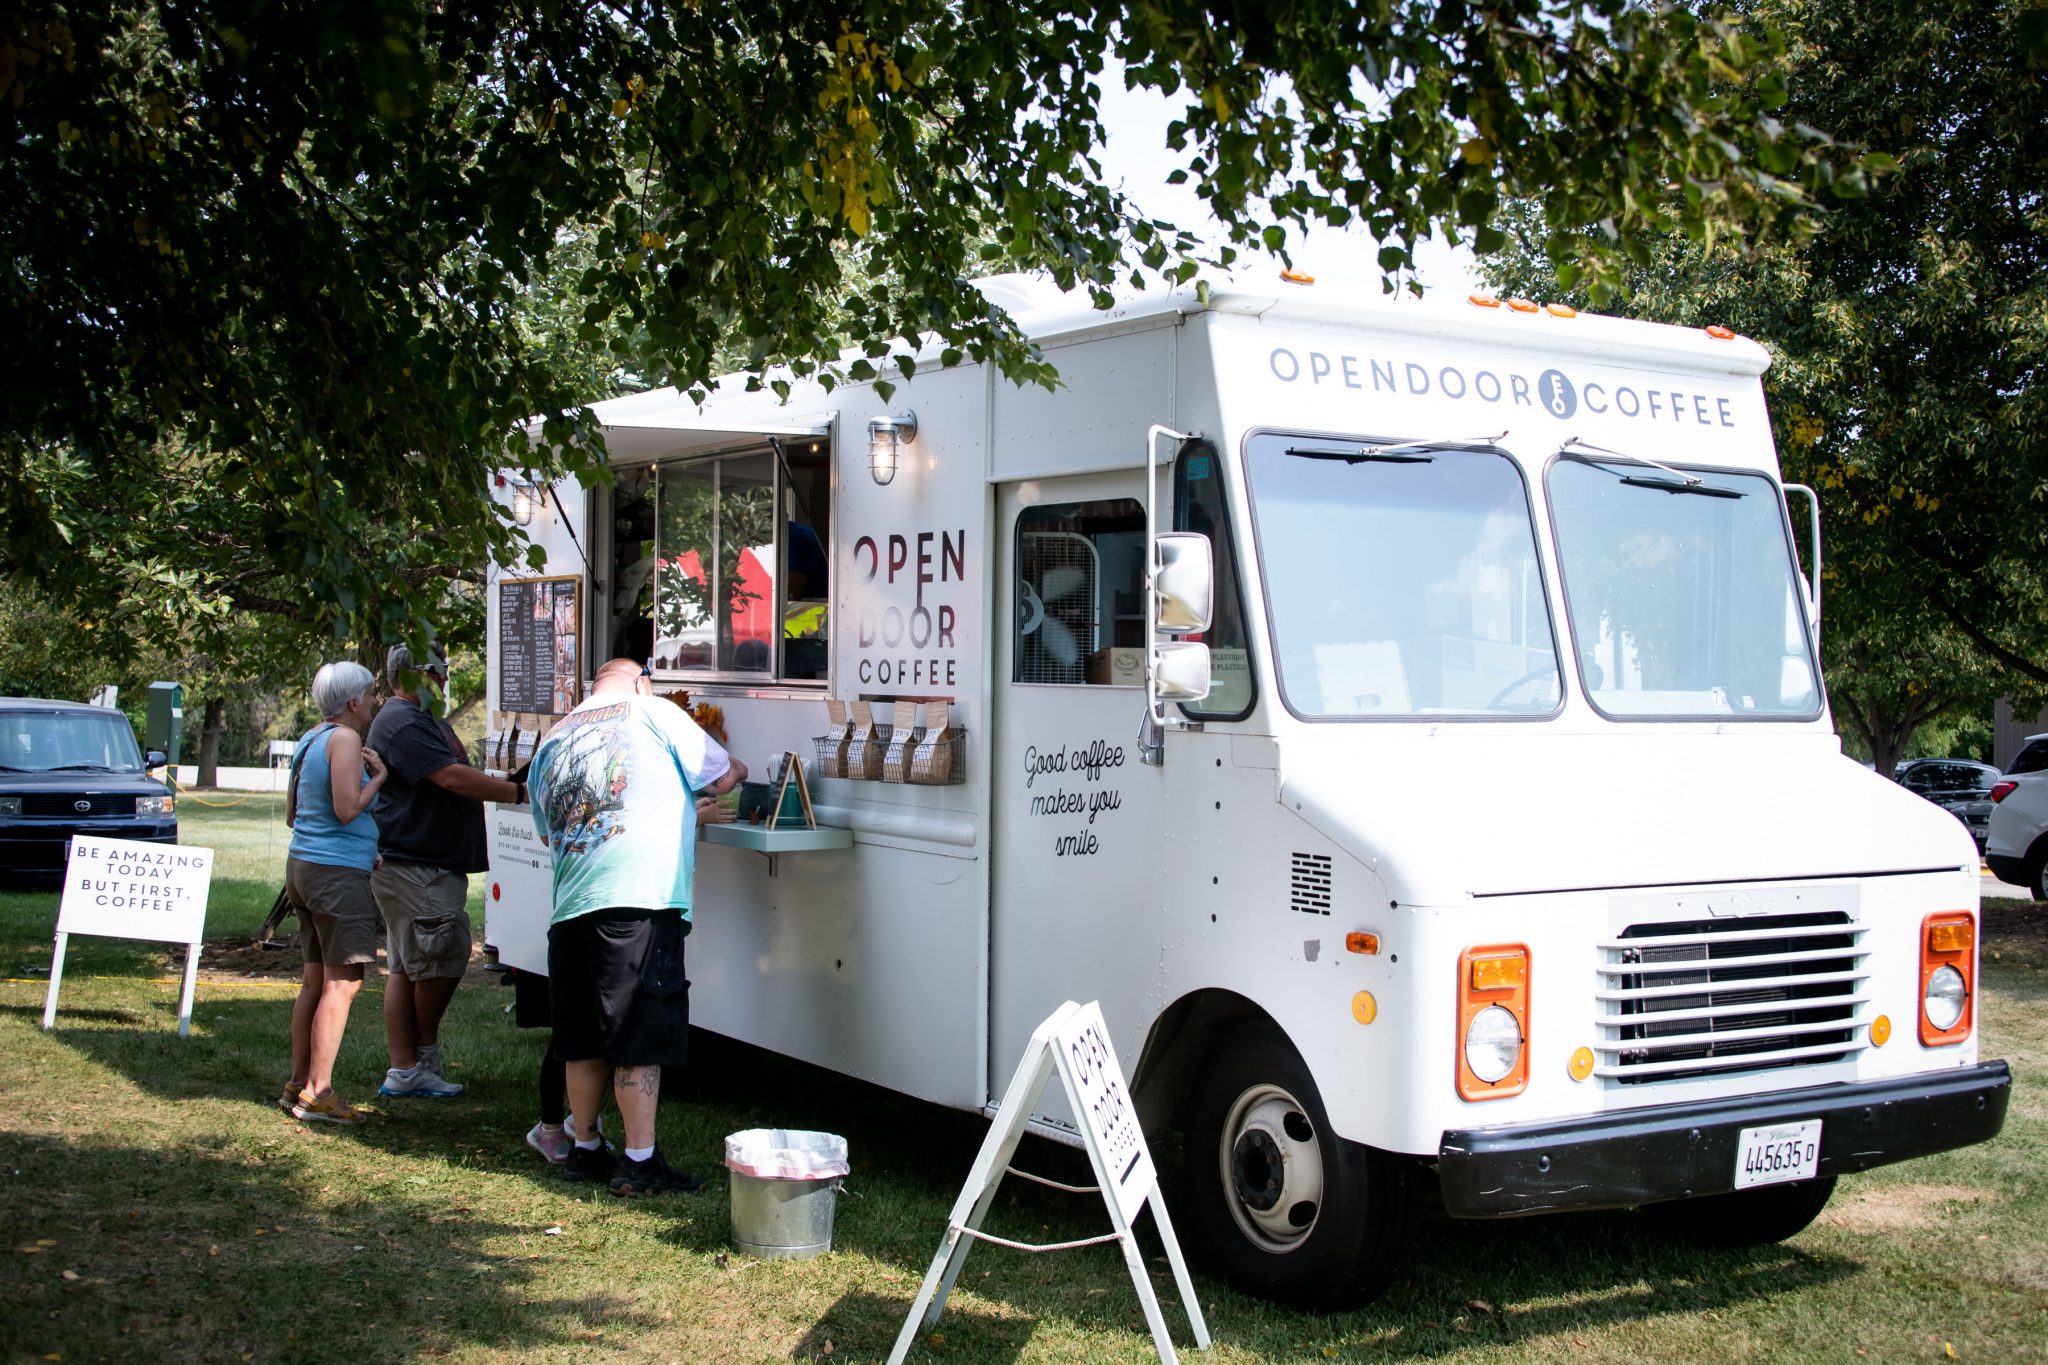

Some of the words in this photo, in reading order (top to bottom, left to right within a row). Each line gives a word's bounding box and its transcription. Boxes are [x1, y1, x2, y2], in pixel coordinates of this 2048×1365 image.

[1583, 382, 1736, 428] COFFEE
[853, 529, 965, 586] OPEN
[858, 604, 956, 650] DOOR
[858, 658, 956, 686] COFFEE
[1024, 744, 1068, 789] Good
[1071, 739, 1125, 781] coffee
[1030, 788, 1086, 816] makes
[1088, 790, 1122, 824] you
[77, 846, 100, 859] BE
[108, 849, 204, 869] AMAZING
[1055, 828, 1099, 857] smile
[106, 863, 174, 879] TODAY
[81, 879, 120, 893] BUT
[129, 883, 190, 900] FIRST,
[95, 894, 174, 912] COFFEE
[1072, 1021, 1110, 1087] OPEN
[1093, 1081, 1126, 1140] DOOR
[1745, 1140, 1802, 1175] 445635
